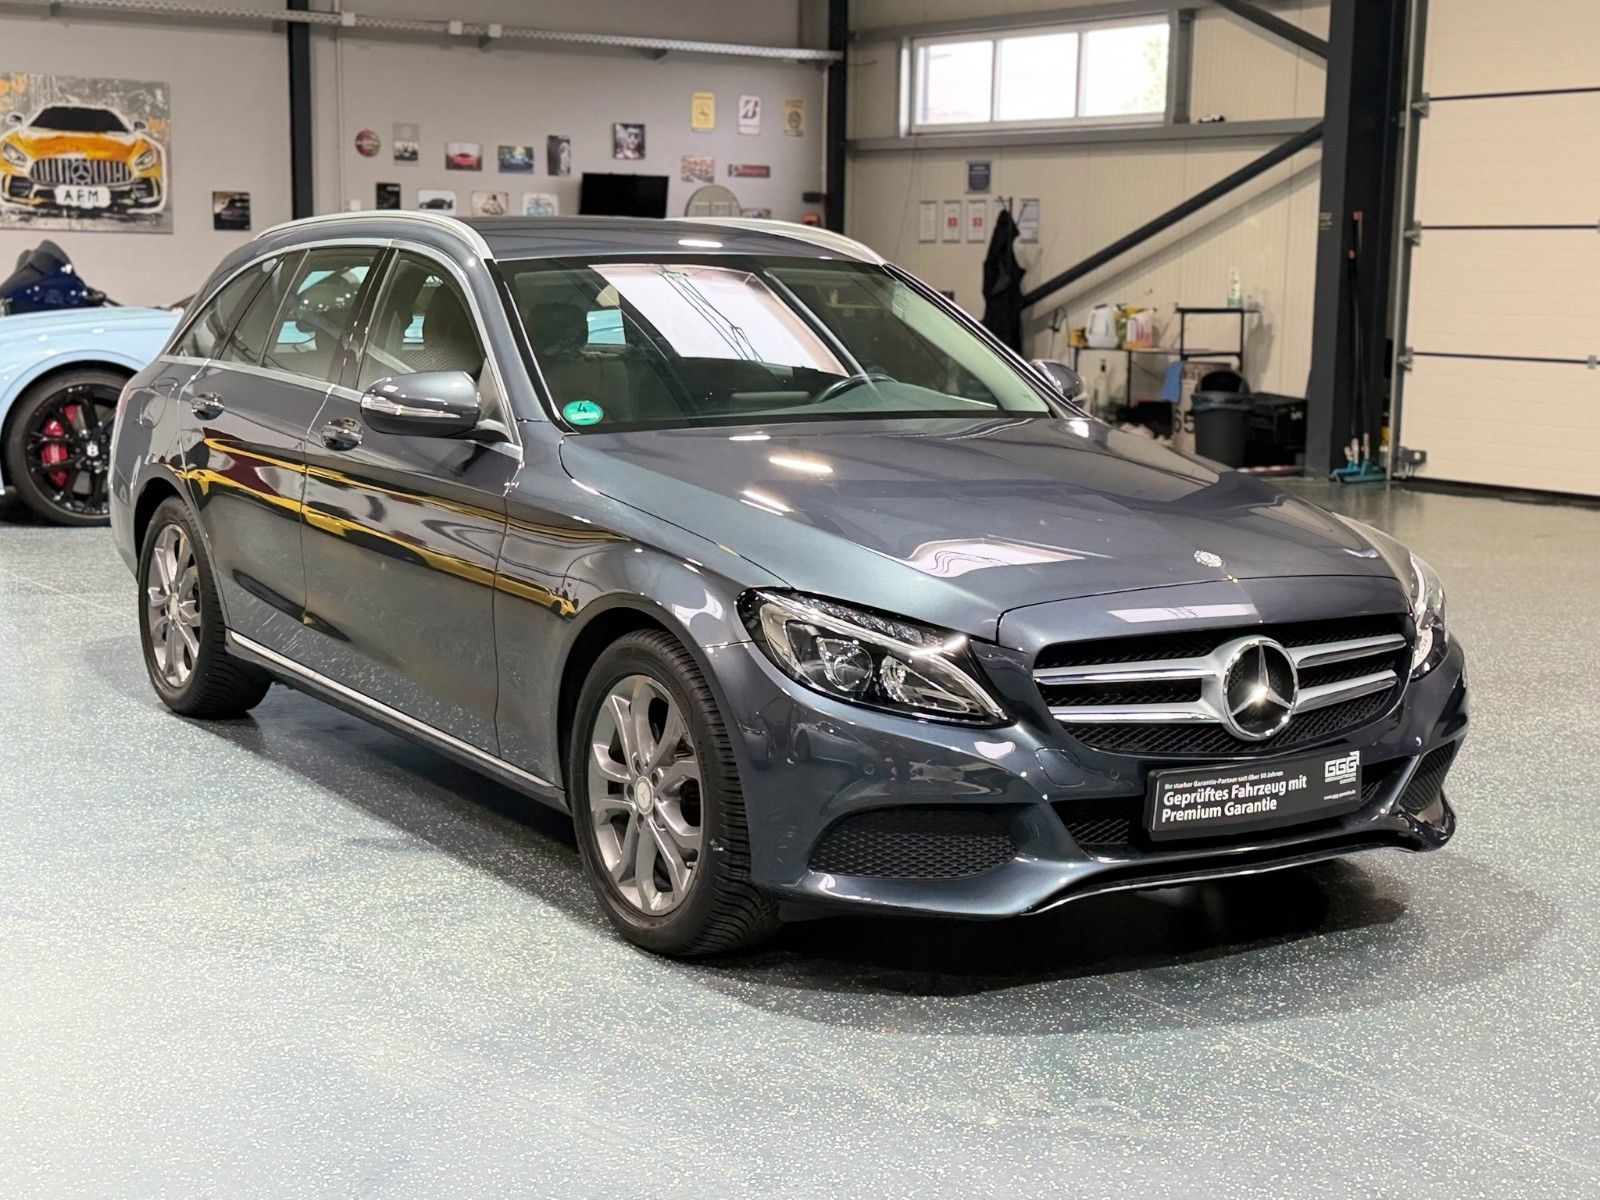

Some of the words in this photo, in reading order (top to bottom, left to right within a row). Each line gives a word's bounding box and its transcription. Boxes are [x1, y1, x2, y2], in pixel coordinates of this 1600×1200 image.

[577, 402, 587, 413] 4
[1325, 753, 1358, 778] GGG
[1163, 787, 1229, 807] Geprüftes
[1231, 780, 1287, 799] Fahrzeug
[1288, 774, 1307, 792] mit
[1162, 803, 1222, 823] Premium
[1224, 797, 1277, 816] Garantie
